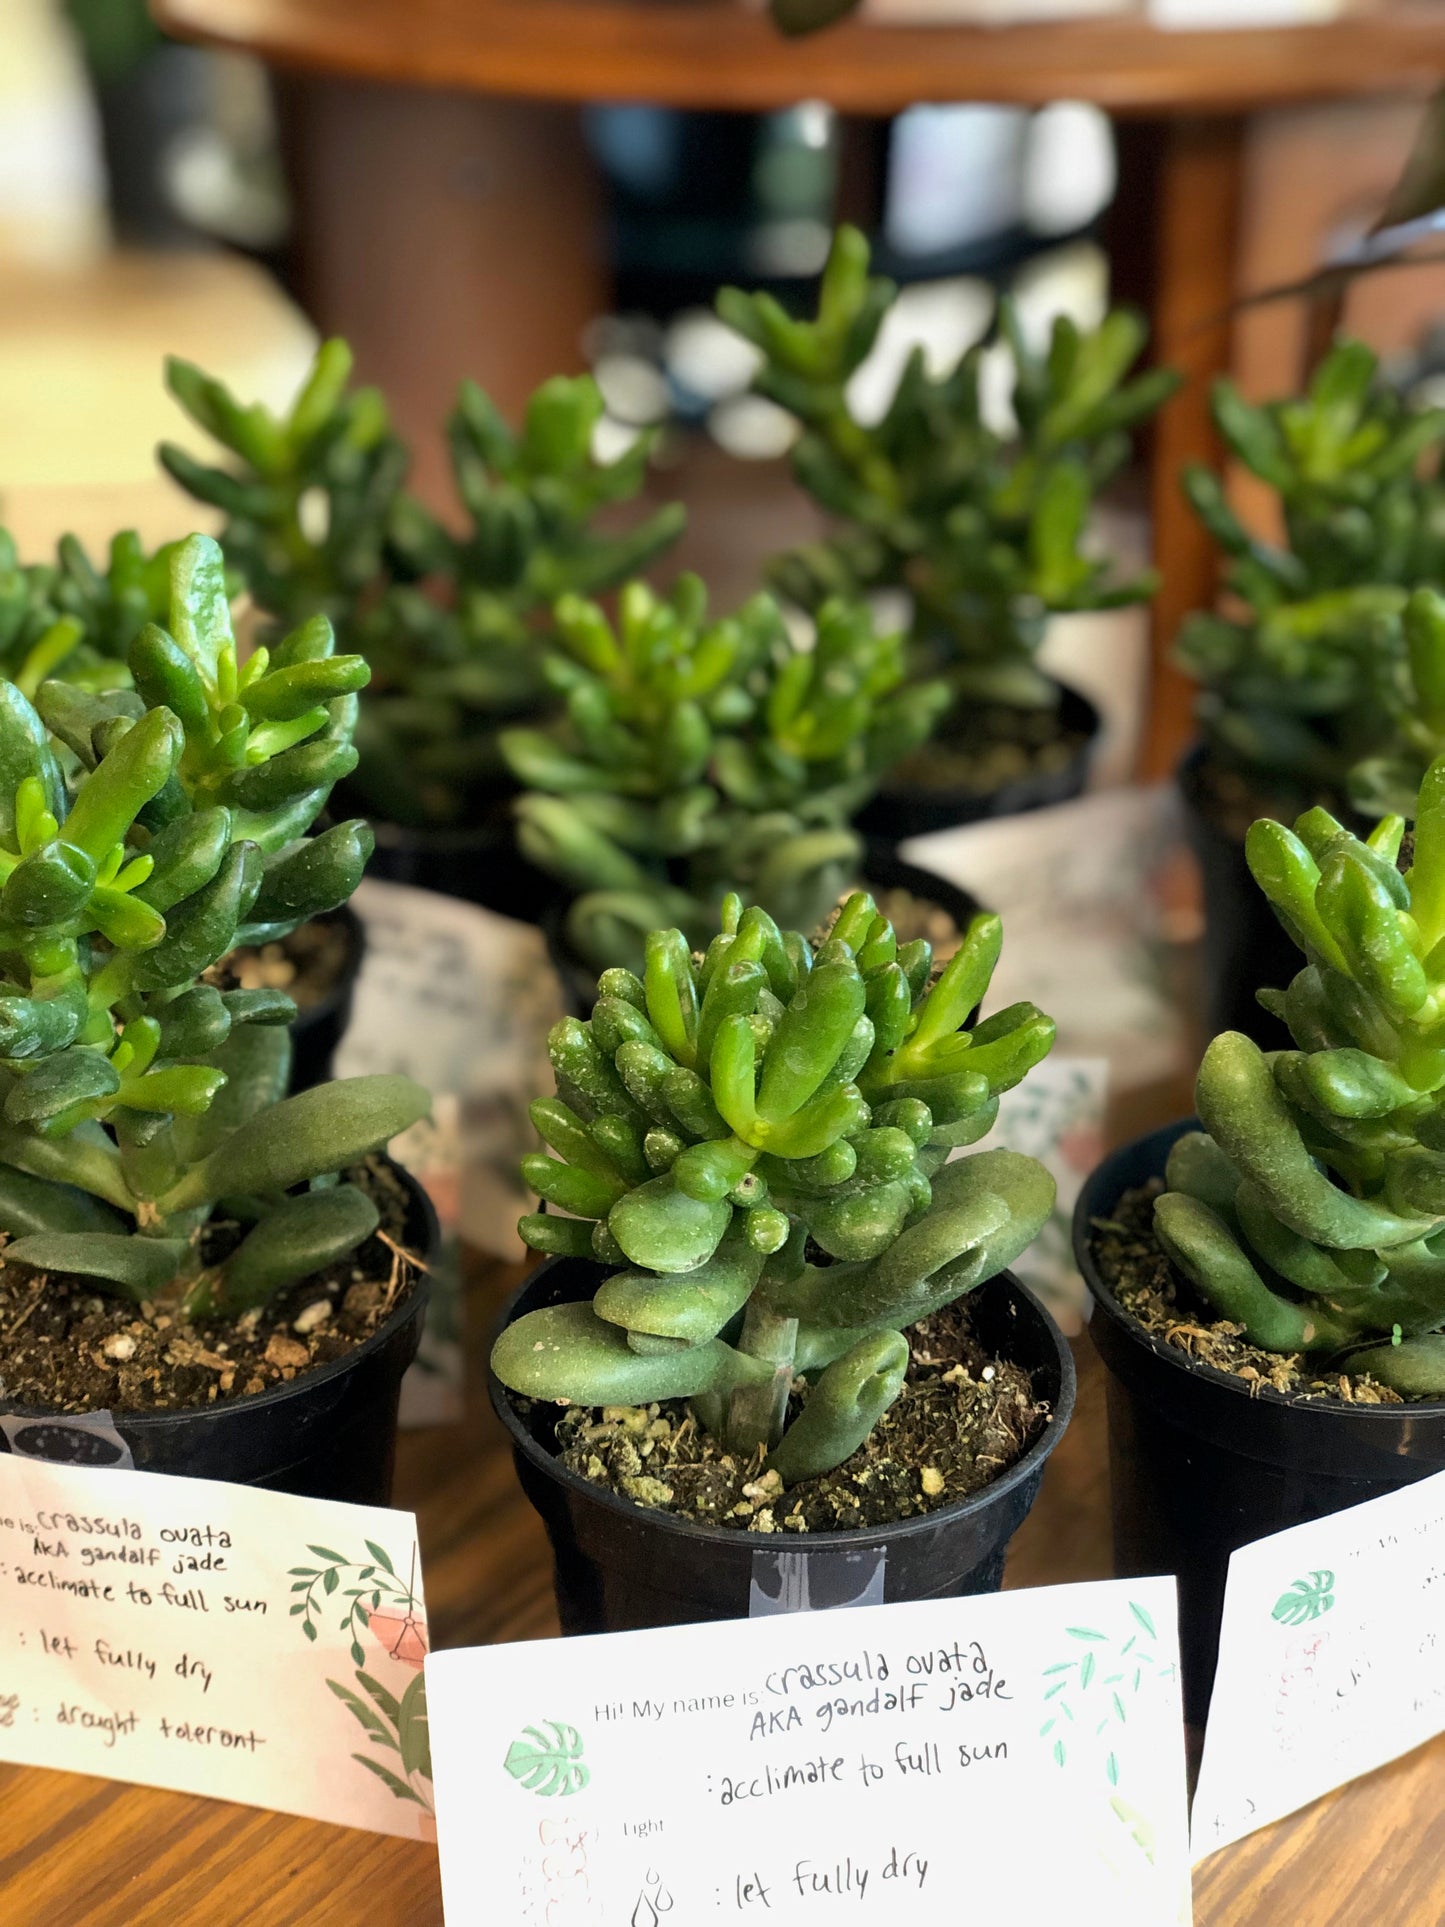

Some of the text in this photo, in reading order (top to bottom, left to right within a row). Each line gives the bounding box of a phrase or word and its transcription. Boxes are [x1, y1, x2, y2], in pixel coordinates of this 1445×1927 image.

[36, 1511, 142, 1540] crassula
[159, 1525, 232, 1549] ovata
[80, 1547, 161, 1567] gandalf
[172, 1552, 228, 1575] jade
[16, 1566, 116, 1602] acclimate
[126, 1581, 152, 1606] to
[157, 1582, 210, 1612] full
[223, 1595, 268, 1615] sun
[40, 1629, 78, 1660] let
[93, 1638, 156, 1680] fully
[174, 1653, 212, 1693] dry
[594, 1702, 624, 1721] Hi!
[632, 1699, 665, 1721] My
[673, 1693, 735, 1714] name
[765, 1650, 889, 1695] crassula
[905, 1641, 988, 1675] ovata
[750, 1668, 1014, 1741] AKA gandalf jade
[720, 1755, 845, 1806] acclimate
[857, 1753, 884, 1787] to
[894, 1741, 941, 1776] full
[957, 1741, 1008, 1767] sun
[735, 1872, 772, 1910] let
[792, 1856, 868, 1899] fully
[881, 1846, 929, 1888] dry
